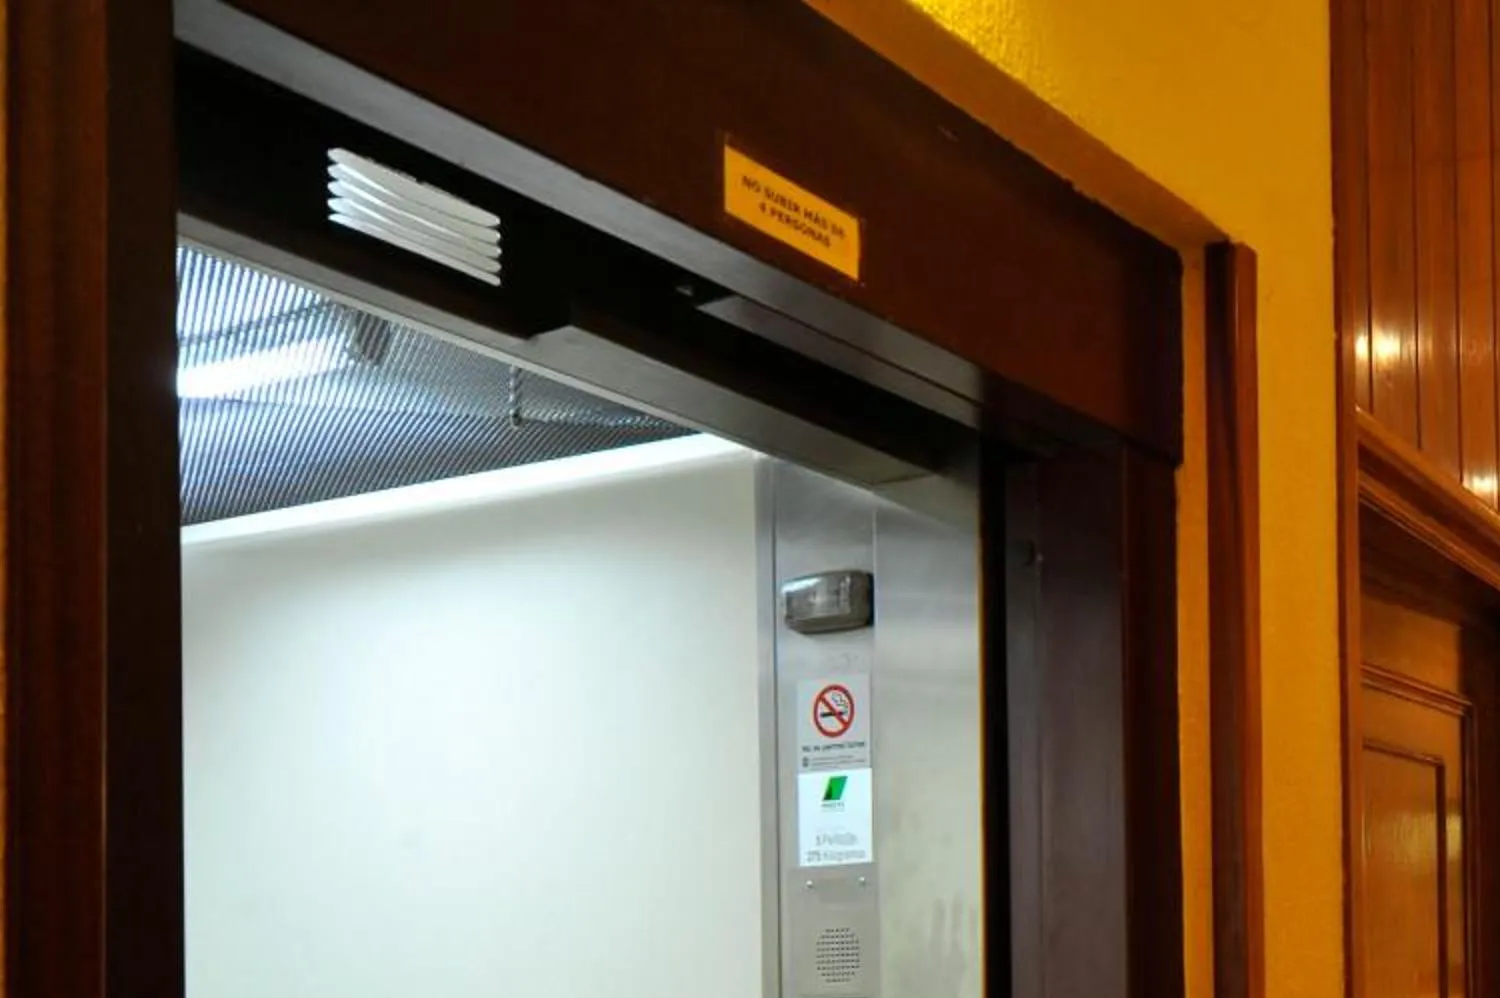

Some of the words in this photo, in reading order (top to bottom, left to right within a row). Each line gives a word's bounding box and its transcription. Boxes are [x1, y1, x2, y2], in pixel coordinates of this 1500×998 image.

[742, 175, 761, 193] NO
[764, 187, 801, 213] SUBIR
[770, 207, 831, 248] PERSONAS
